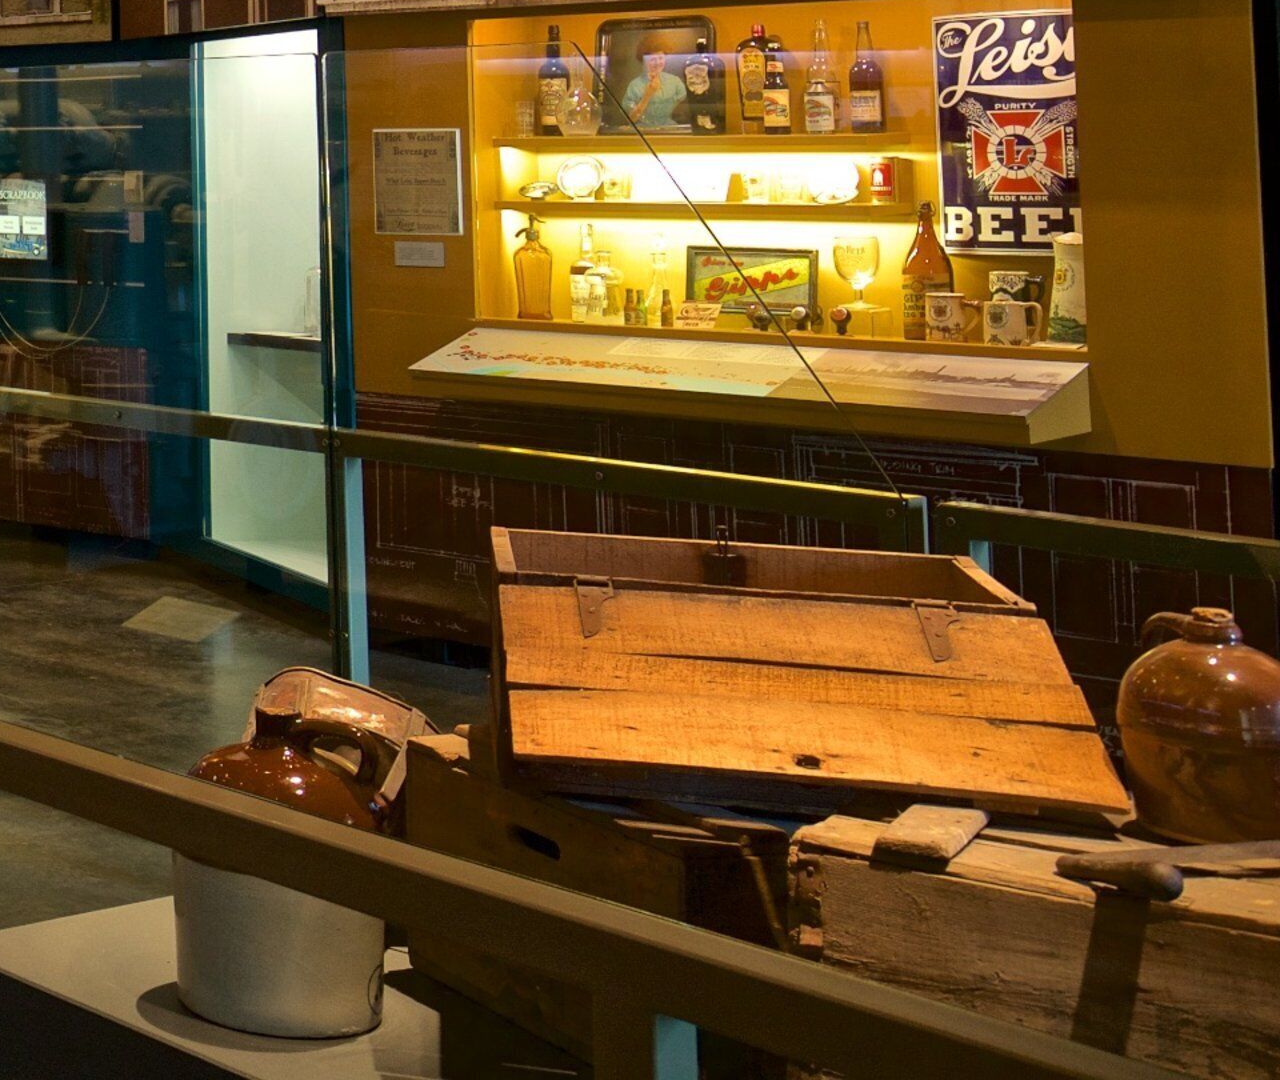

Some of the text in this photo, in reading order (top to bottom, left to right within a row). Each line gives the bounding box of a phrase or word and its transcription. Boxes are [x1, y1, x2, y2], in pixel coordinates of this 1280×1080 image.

[940, 31, 963, 50] The
[994, 102, 1037, 110] PURITY
[383, 132, 446, 142] Hot Weather
[392, 146, 438, 158] Beverages
[1065, 126, 1076, 179] STRENGTH
[0, 189, 46, 200] SCRAPBOOK
[1019, 194, 1049, 202] MARK
